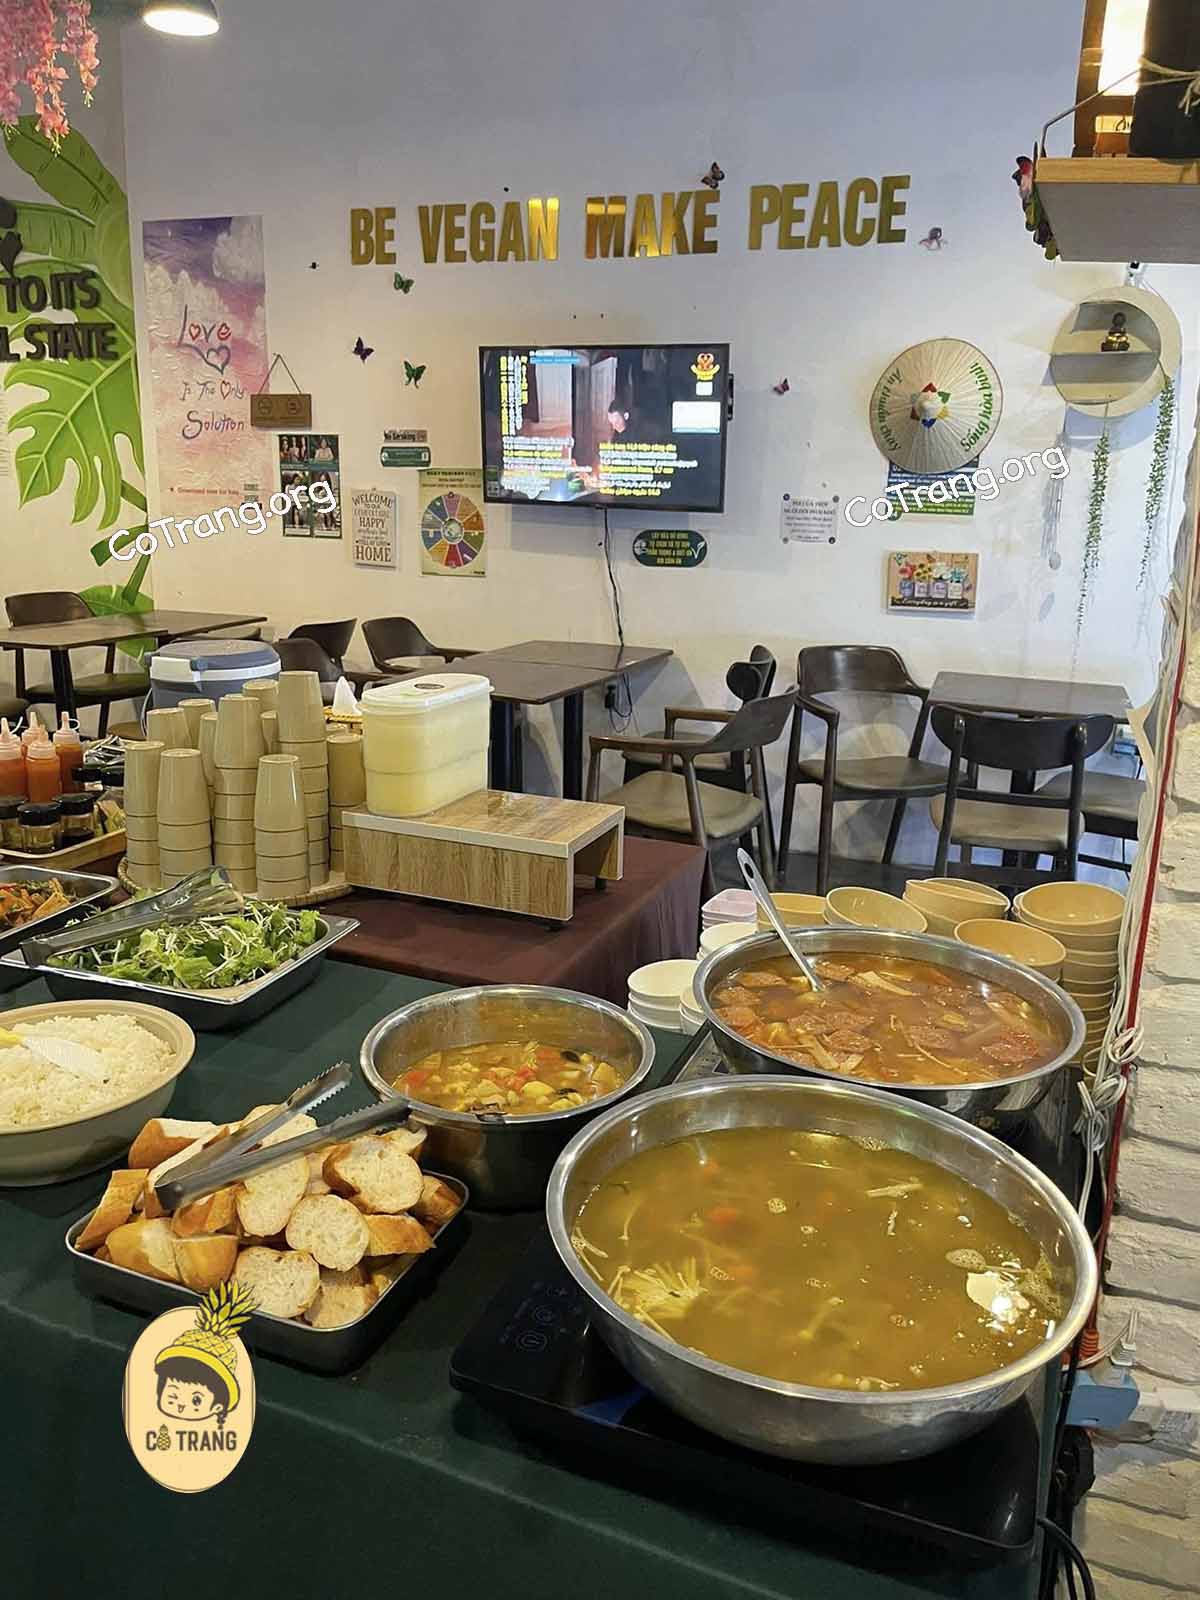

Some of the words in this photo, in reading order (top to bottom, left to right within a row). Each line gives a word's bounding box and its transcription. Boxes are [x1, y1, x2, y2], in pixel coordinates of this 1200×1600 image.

[351, 207, 397, 265] BE
[417, 197, 560, 264] VEGAN
[585, 189, 720, 260] MAKE
[748, 175, 911, 251] PEACE
[0, 274, 47, 314] TO
[50, 270, 101, 310] ITS
[24, 322, 119, 361] STATE
[177, 304, 231, 355] Love
[196, 381, 216, 400] The
[220, 379, 246, 400] Only
[182, 410, 245, 440] Solution
[960, 422, 990, 452] Sống
[352, 493, 392, 509] WELCOME
[360, 517, 385, 528] HAPPY
[356, 545, 392, 562] HOME
